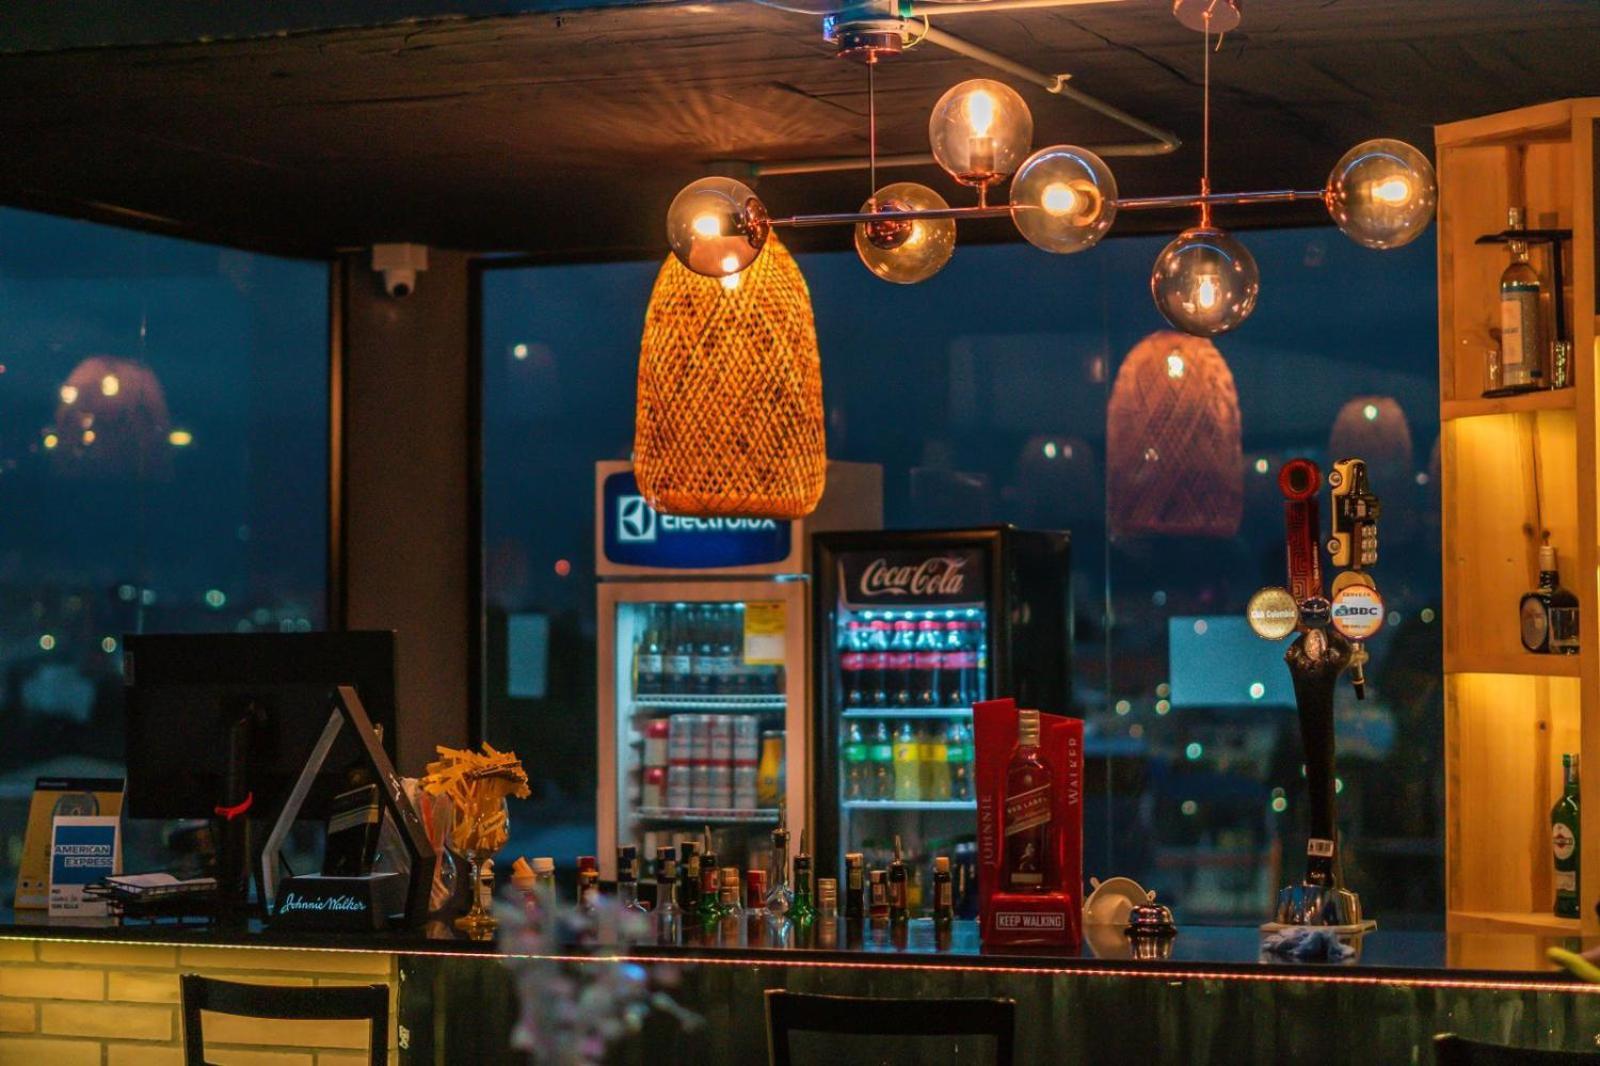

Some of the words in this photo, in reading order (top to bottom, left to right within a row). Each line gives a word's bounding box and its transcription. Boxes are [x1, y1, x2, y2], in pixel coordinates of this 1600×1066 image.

[861, 558, 968, 595] Coca-Cola
[1350, 607, 1378, 616] BBC
[1068, 738, 1078, 805] WALKER
[982, 795, 995, 865] JOHNNIE
[54, 845, 110, 855] AMERICAN
[64, 857, 113, 867] EXPRESS
[281, 893, 323, 914] Johnnie
[322, 895, 366, 911] Walker
[1000, 915, 1020, 927] KEEP
[1023, 915, 1061, 927] WALKING
